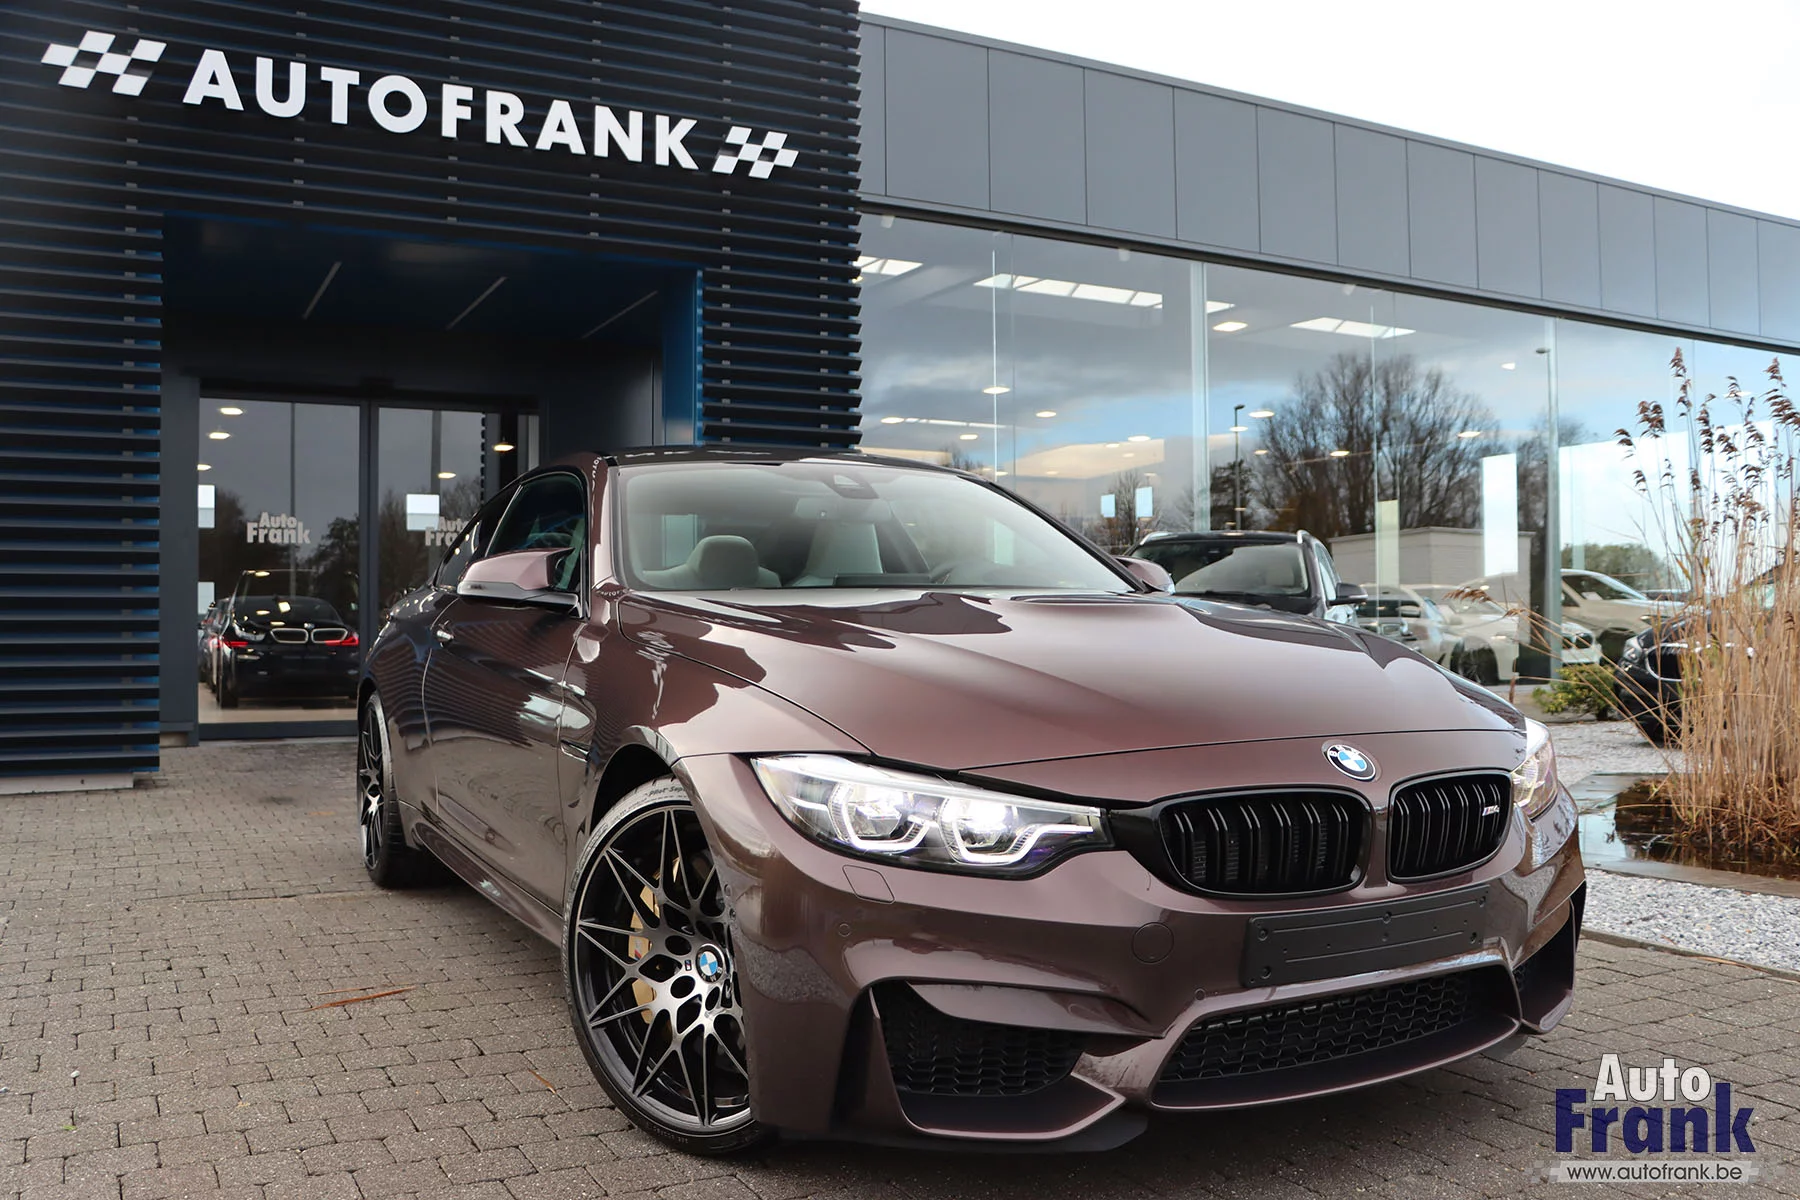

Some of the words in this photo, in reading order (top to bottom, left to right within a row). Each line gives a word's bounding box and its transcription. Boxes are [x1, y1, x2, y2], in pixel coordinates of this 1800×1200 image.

[183, 48, 699, 170] AUTOFRANK
[259, 511, 298, 528] Auto
[247, 521, 311, 544] Frank
[425, 527, 459, 547] Fra
